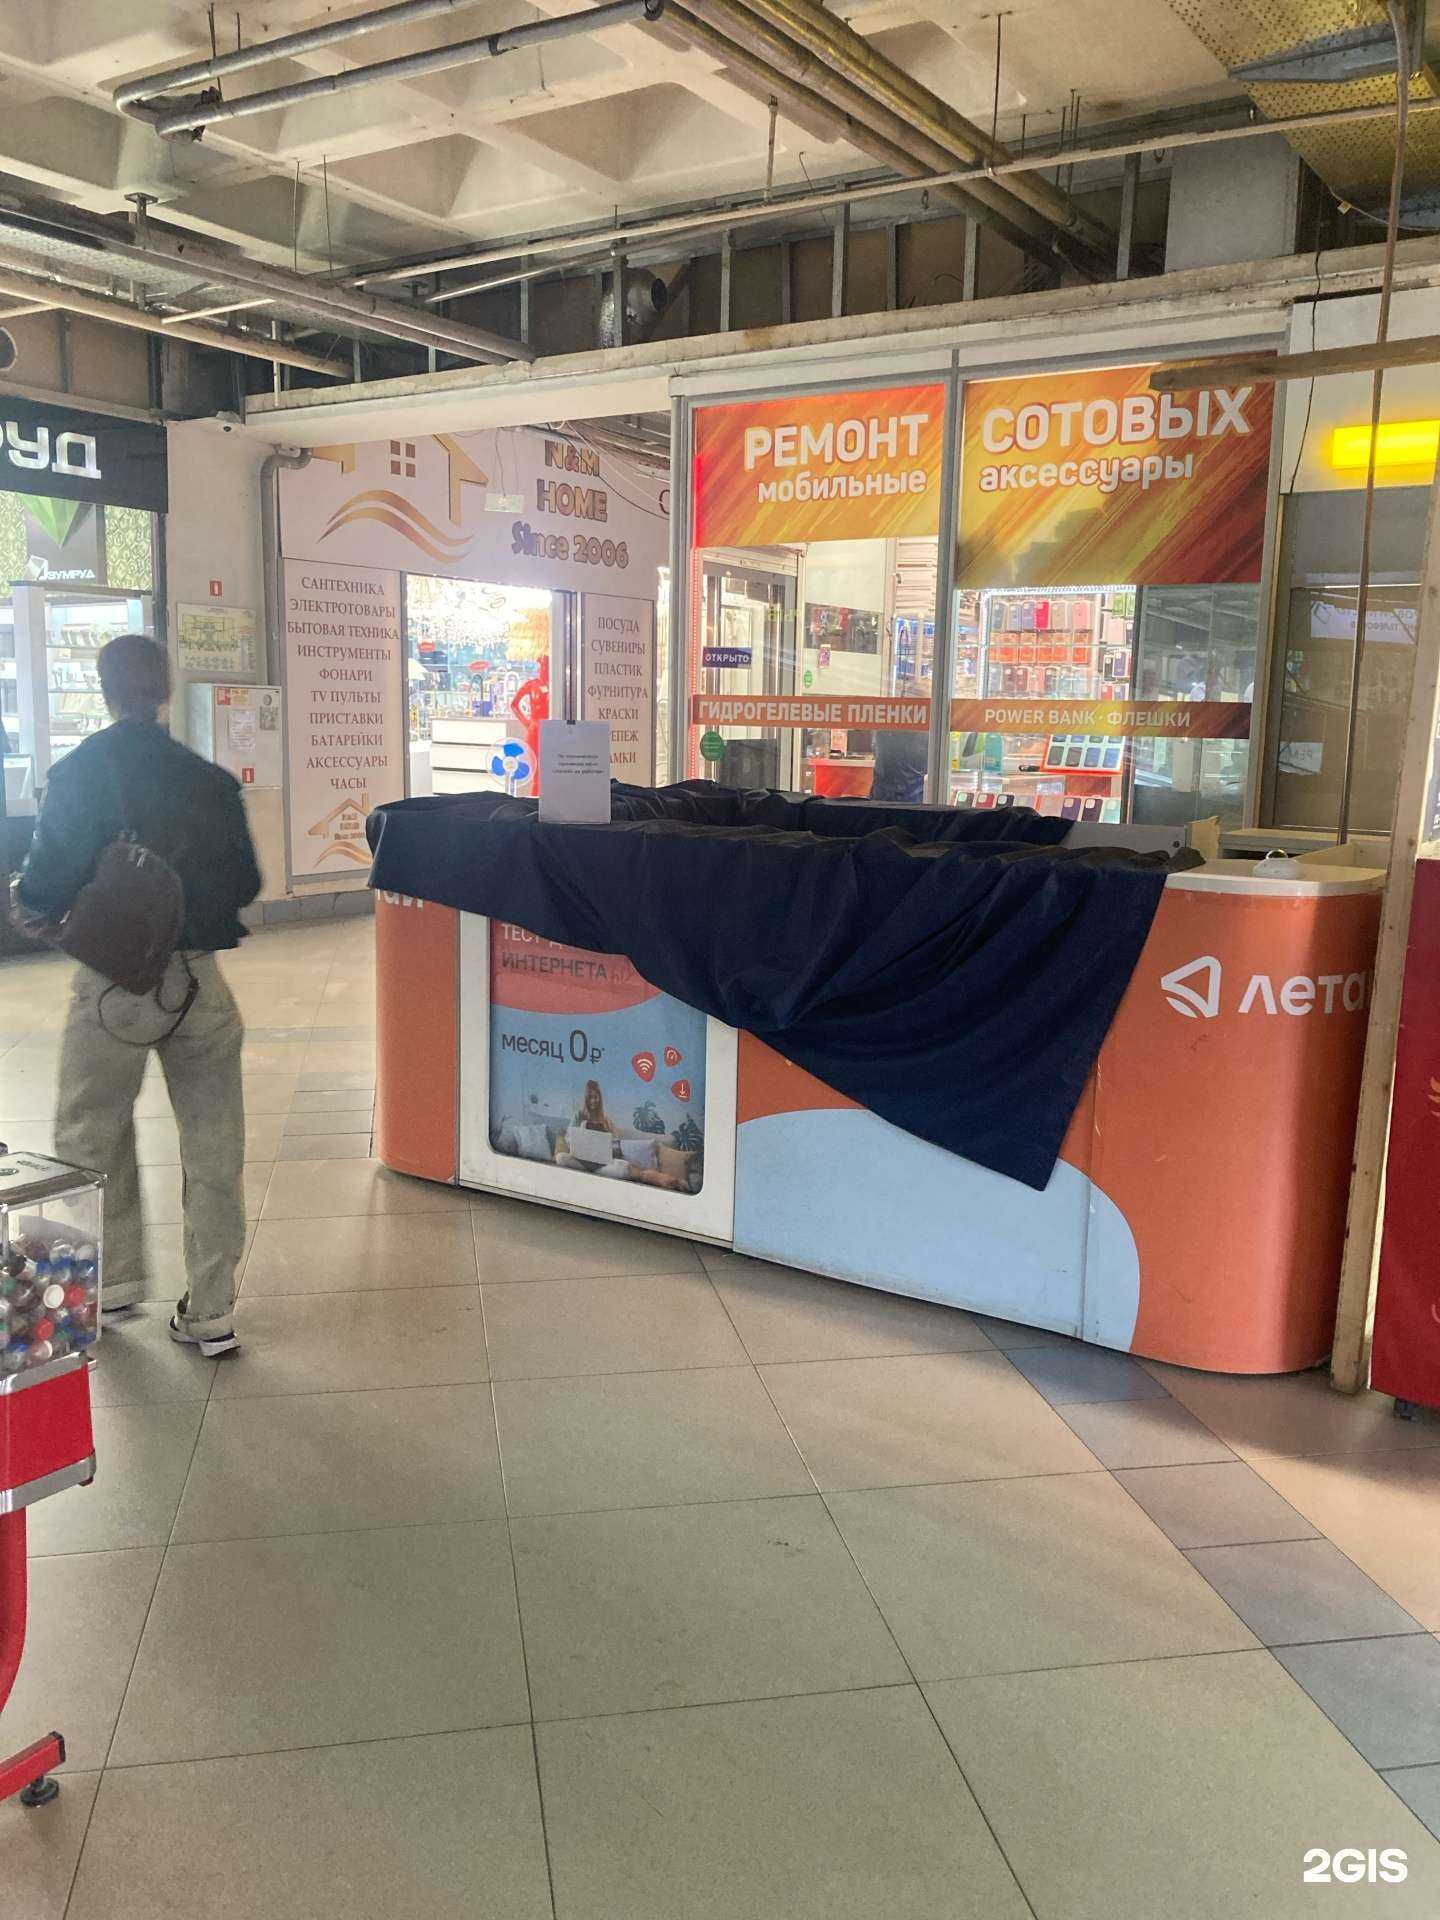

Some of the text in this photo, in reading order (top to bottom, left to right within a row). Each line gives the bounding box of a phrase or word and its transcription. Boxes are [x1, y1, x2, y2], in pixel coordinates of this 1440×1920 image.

[981, 386, 1253, 453] СОТОВЫХ
[0, 421, 102, 479] УД
[744, 413, 929, 470] РЕМОНТ
[545, 439, 600, 476] N&M
[979, 453, 1193, 493] аксессуары
[757, 469, 927, 503] мобильные
[537, 478, 608, 523] HOME
[511, 520, 630, 569] Since 2006
[301, 576, 385, 595] САНТЕХНИКА
[289, 598, 396, 618] ЭЛЕКТРОТОВАРЫ
[287, 621, 400, 640] БЫТОВАЯ ТЕХНИКА
[598, 616, 640, 634] ПОСУДА
[297, 644, 391, 661] ИНСТРУМЕНТЫ
[591, 639, 646, 655] СУВЕНИРЫ
[705, 652, 750, 664] ОТКРЫТО
[319, 668, 373, 682] ФОНАРИ
[594, 662, 642, 677] ПЛАСТИК
[311, 690, 381, 705] TV ПУЛЬТЫ
[587, 684, 648, 700] ФУРНИТУРА
[309, 712, 384, 725] ПРИСТАВКИ
[598, 707, 639, 720] КРАСКИ
[700, 700, 927, 724] ГИДРОГЕЛЕВЫЕ ПЛЕНКИ
[985, 708, 1191, 728] POWER BANK ФЛЕШКИ
[311, 732, 383, 746] БАТАРЕЙКИ
[611, 729, 639, 742] ЕПЕЖ
[306, 755, 388, 770] АКСЕССУАРЫ
[330, 777, 367, 790] ЧАСЫ
[502, 951, 607, 980] ИНТЕРНЕТА
[501, 1033, 564, 1064] месяц
